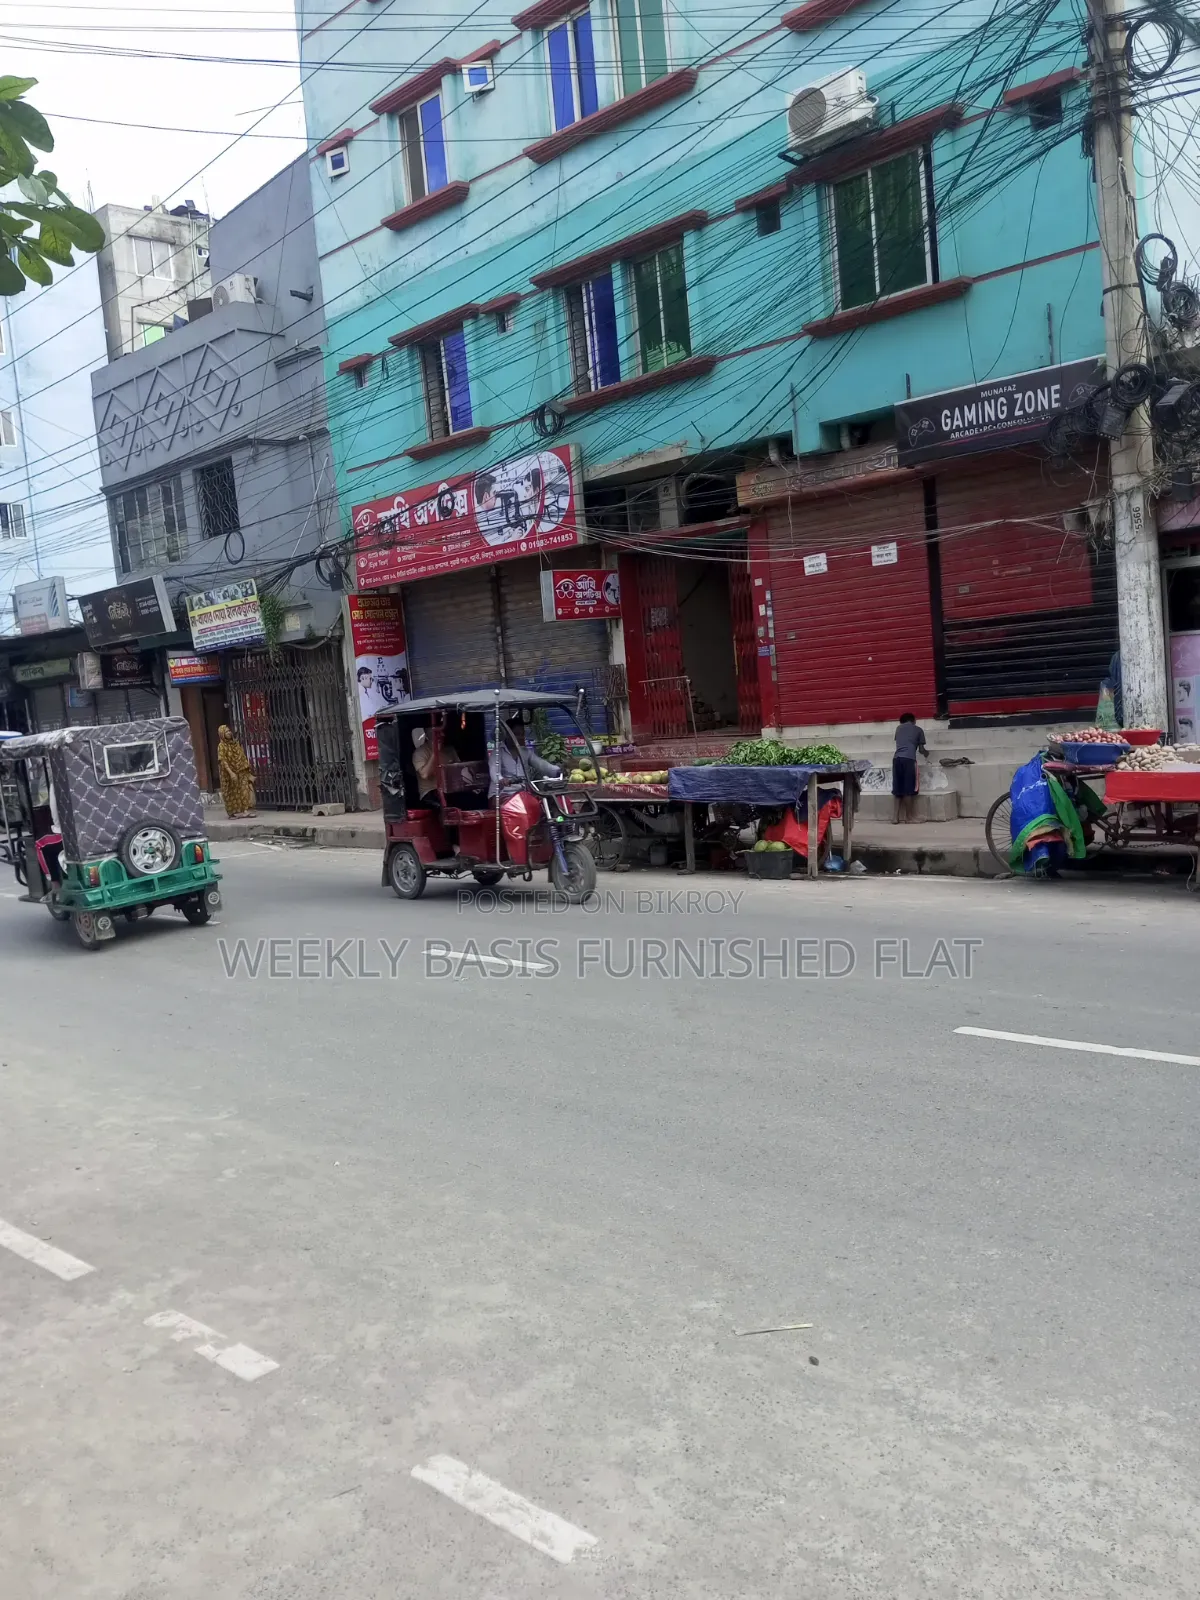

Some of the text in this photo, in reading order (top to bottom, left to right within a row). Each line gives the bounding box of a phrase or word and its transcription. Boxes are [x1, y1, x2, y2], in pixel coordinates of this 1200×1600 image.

[980, 384, 1017, 399] MUNAFAZ
[941, 384, 1061, 432] GAMING ZONE
